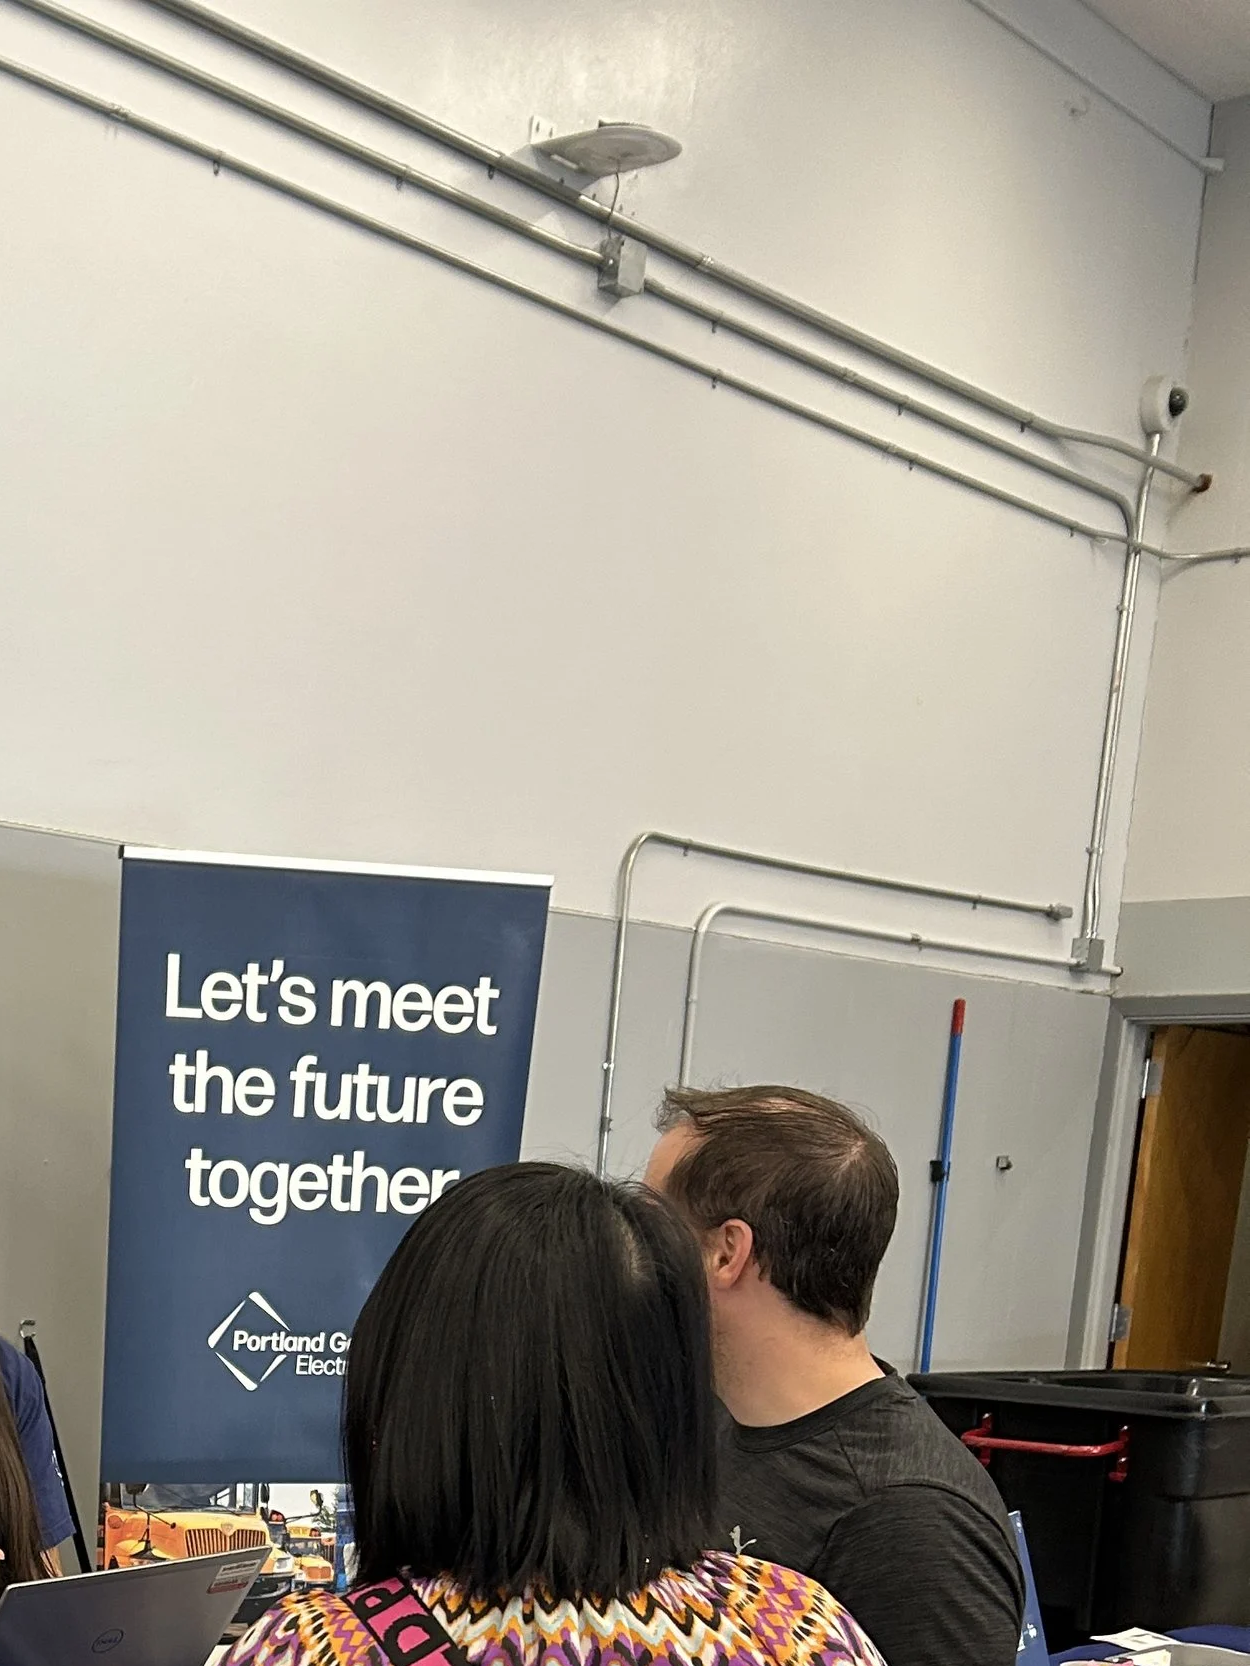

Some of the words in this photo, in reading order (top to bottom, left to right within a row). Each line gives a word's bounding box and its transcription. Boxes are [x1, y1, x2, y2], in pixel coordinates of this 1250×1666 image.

[165, 953, 317, 1026] Let's
[330, 976, 500, 1036] meet
[168, 1049, 276, 1117] the
[289, 1054, 485, 1127] future
[184, 1147, 461, 1226] together
[233, 1330, 326, 1353] Portland
[295, 1354, 346, 1376] Elect
